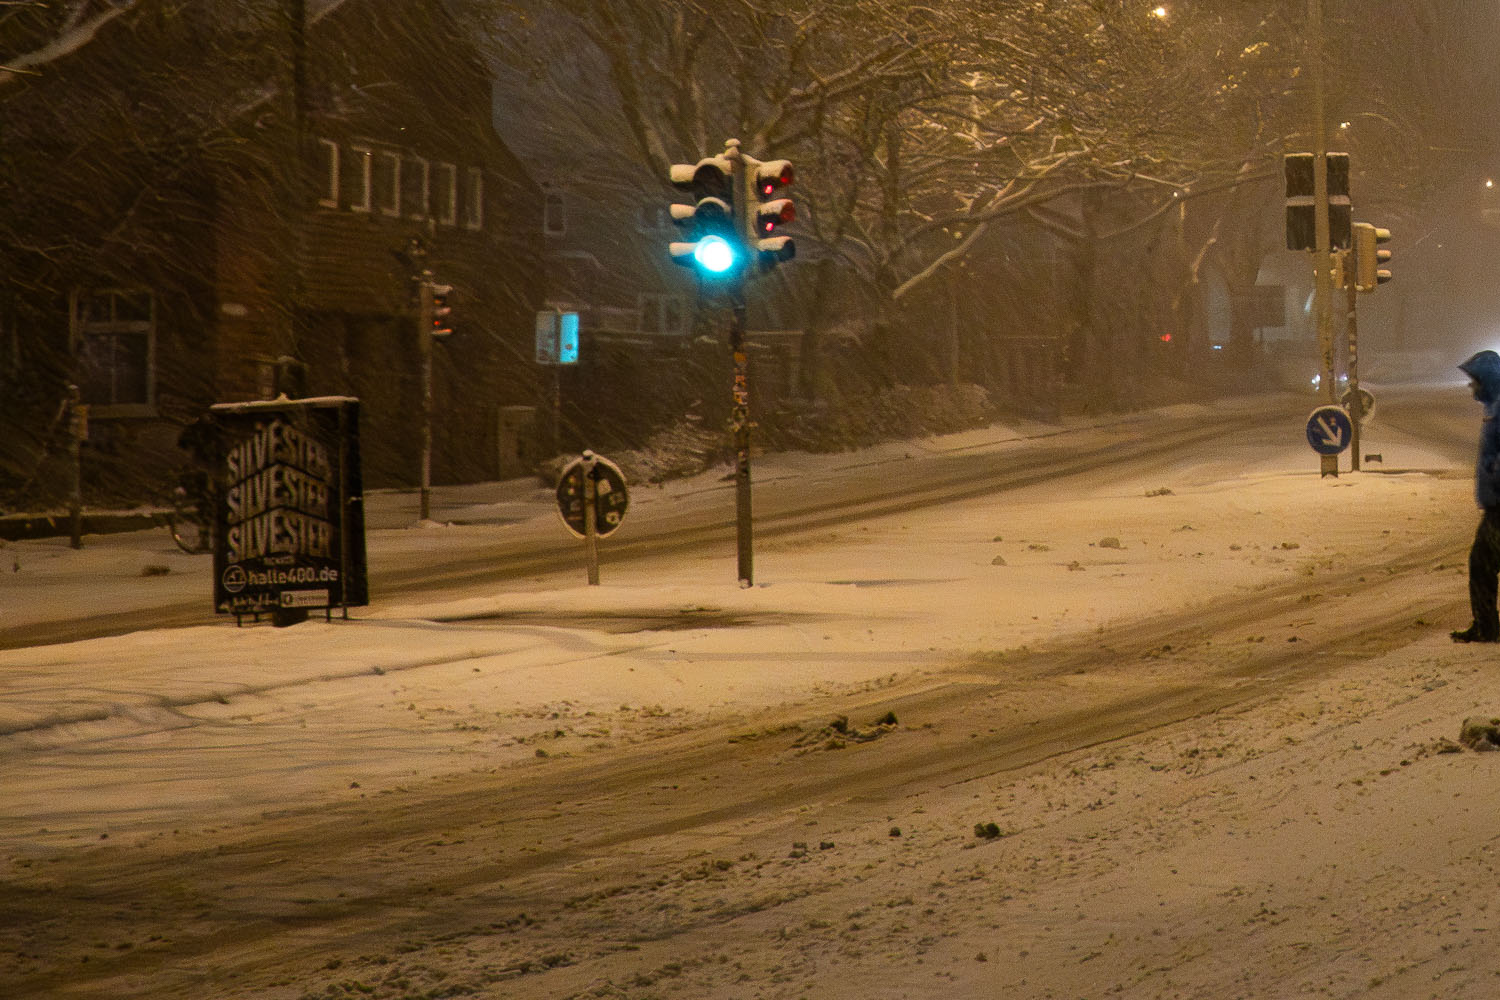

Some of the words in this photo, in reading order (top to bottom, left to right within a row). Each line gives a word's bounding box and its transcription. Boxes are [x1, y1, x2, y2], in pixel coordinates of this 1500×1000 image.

[227, 420, 332, 485] SILVESTER
[227, 464, 329, 524] SILVESTER
[227, 509, 332, 563] SILVESTER
[248, 566, 338, 585] halle400.de
